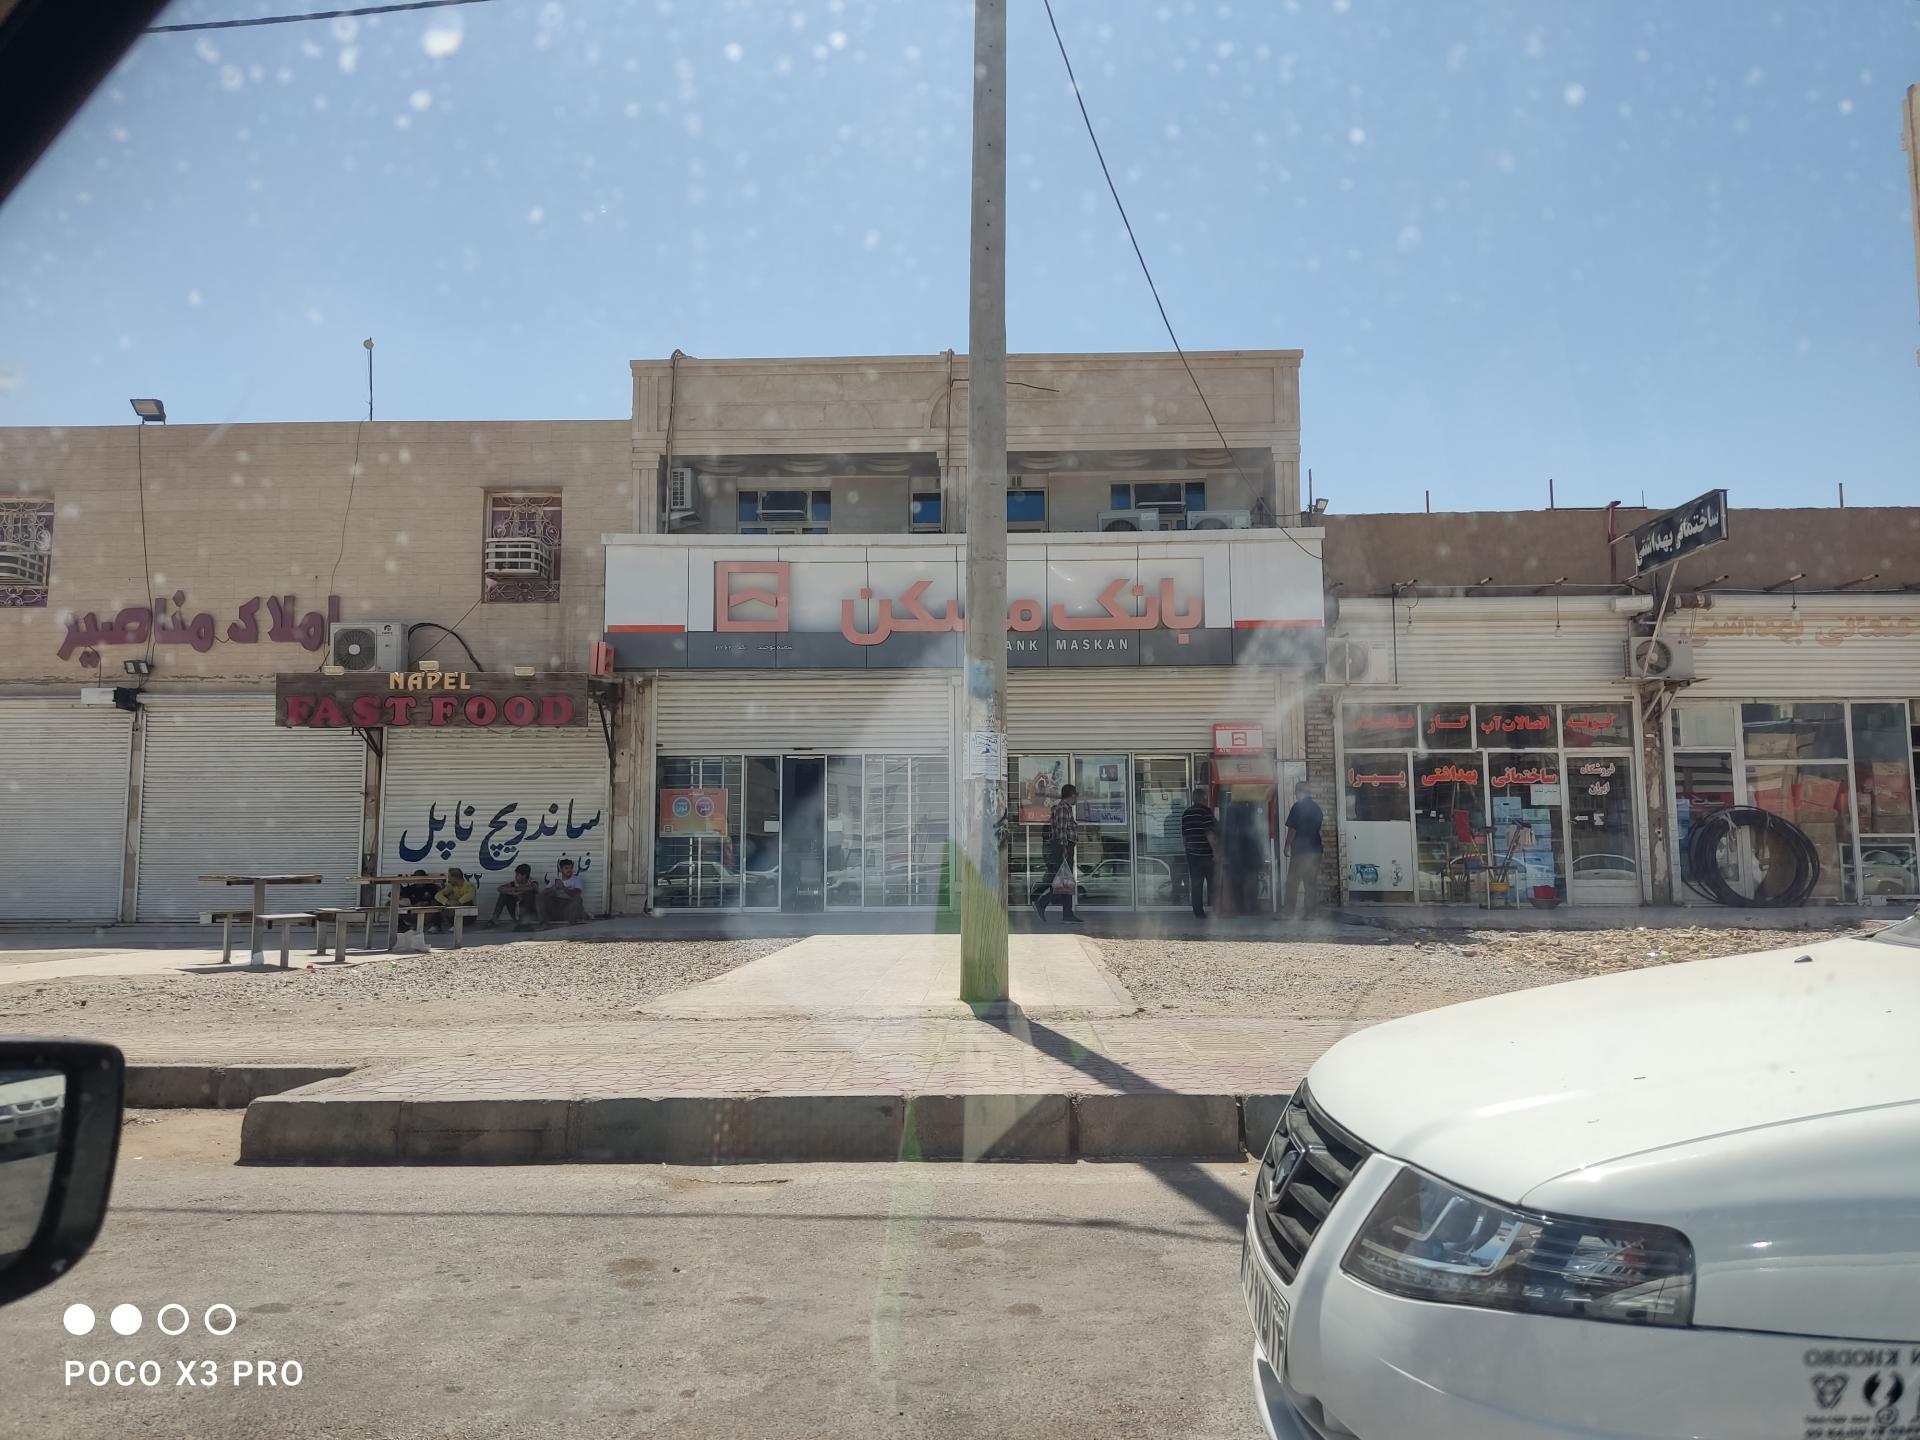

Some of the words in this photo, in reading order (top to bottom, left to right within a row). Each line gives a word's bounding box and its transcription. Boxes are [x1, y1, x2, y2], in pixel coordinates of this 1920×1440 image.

[1675, 503, 1719, 550] ساختمانی
[1636, 530, 1673, 566] بهداشتی
[227, 595, 340, 652] املاک
[1052, 578, 1202, 645] بانک
[57, 590, 214, 668] مناصیر
[1007, 639, 1038, 651] ANK
[1056, 638, 1129, 651] MASKAN
[389, 671, 471, 691] NAPEL
[285, 695, 417, 727] FAST
[430, 695, 575, 727] FOOD
[1421, 765, 1478, 787] بهداشتی
[1491, 767, 1558, 788] ساختمانی
[1580, 763, 1616, 777] فروشگاه
[1588, 781, 1611, 796] ایران
[399, 800, 476, 862] ناپل
[479, 798, 600, 871] ساندویچ
